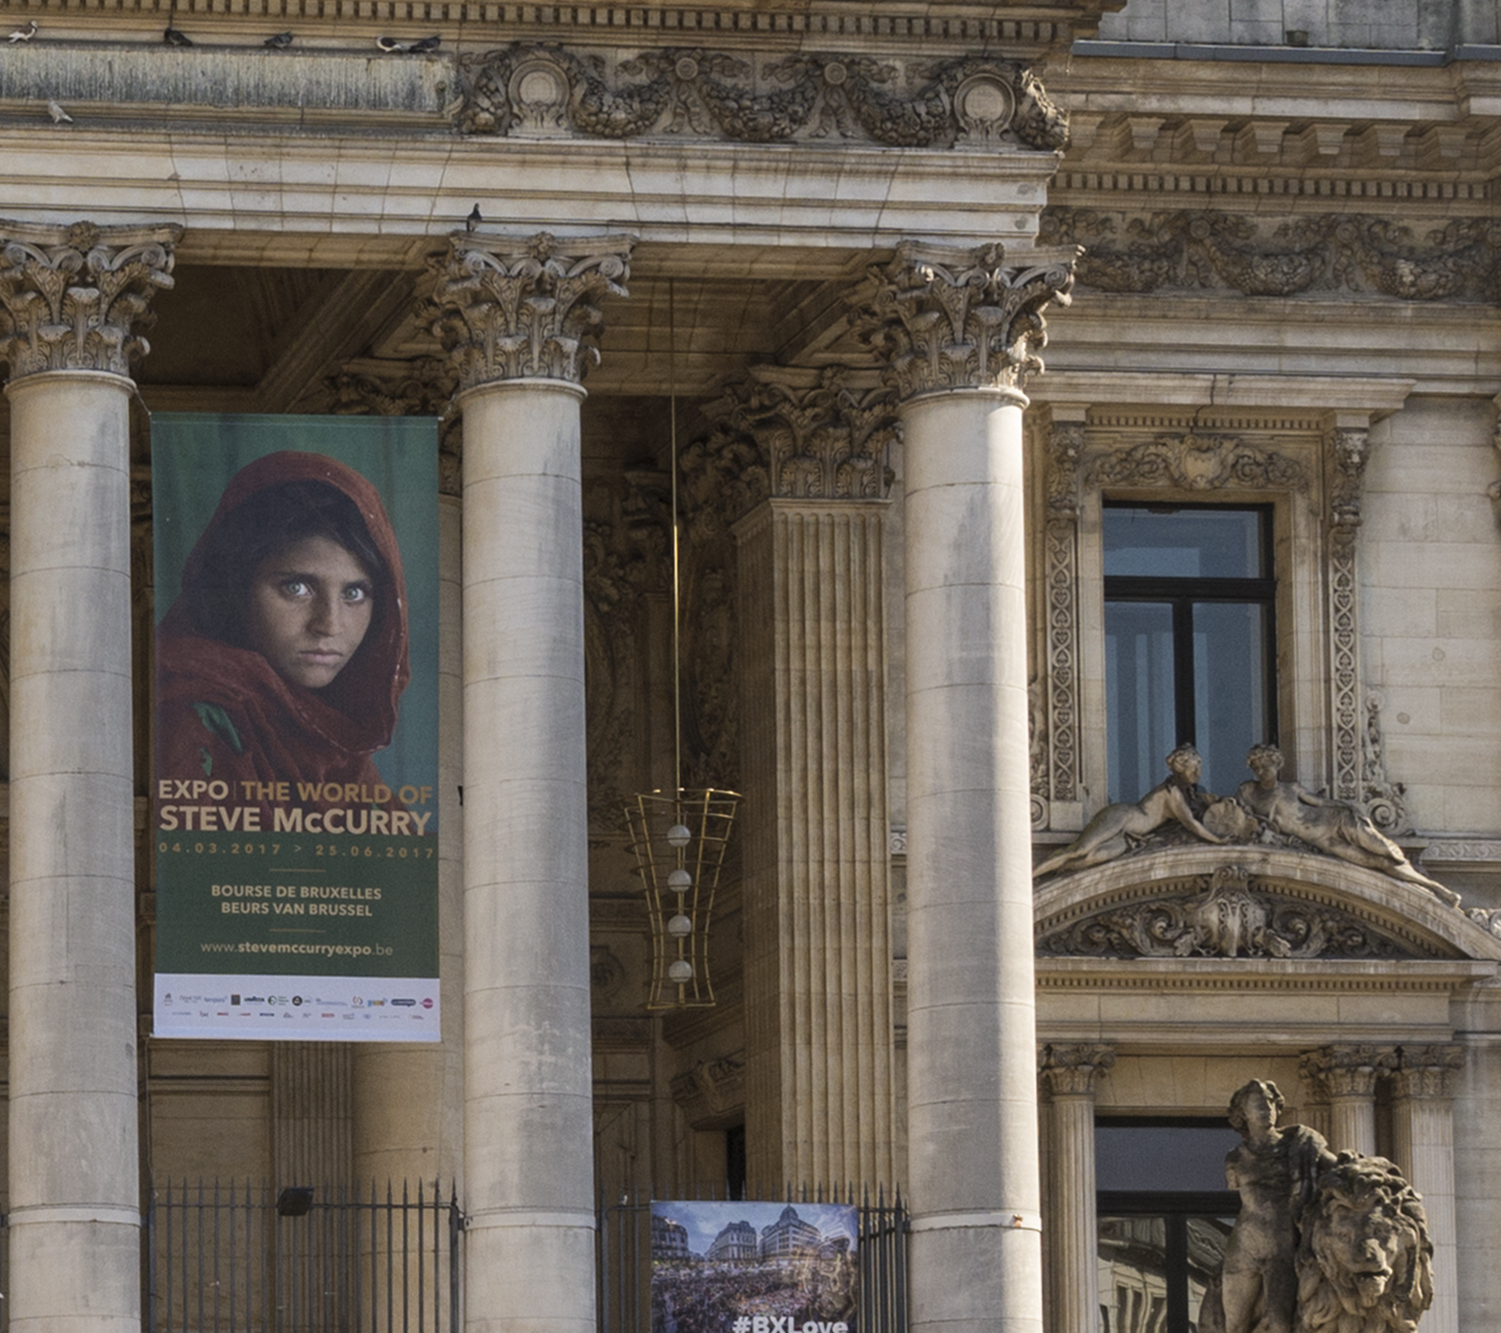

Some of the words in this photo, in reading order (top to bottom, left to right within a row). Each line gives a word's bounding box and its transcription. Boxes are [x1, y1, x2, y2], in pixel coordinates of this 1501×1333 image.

[158, 779, 230, 801] EXPO
[240, 780, 291, 802] THE
[296, 782, 392, 805] WORLD
[398, 785, 434, 806] OF
[159, 804, 262, 833] STEVE
[273, 806, 432, 837] McCURRY
[158, 841, 281, 855] 04.03.2017
[315, 844, 435, 859] 25.06.2017
[211, 884, 273, 898] BOURSE
[276, 885, 297, 899] DE
[300, 886, 383, 901] BRUXELLES
[220, 901, 270, 915] BEURS
[272, 902, 306, 916] VAN
[308, 903, 374, 917] BRUSSEL
[200, 941, 394, 958] www.stevemccurryexpo.be
